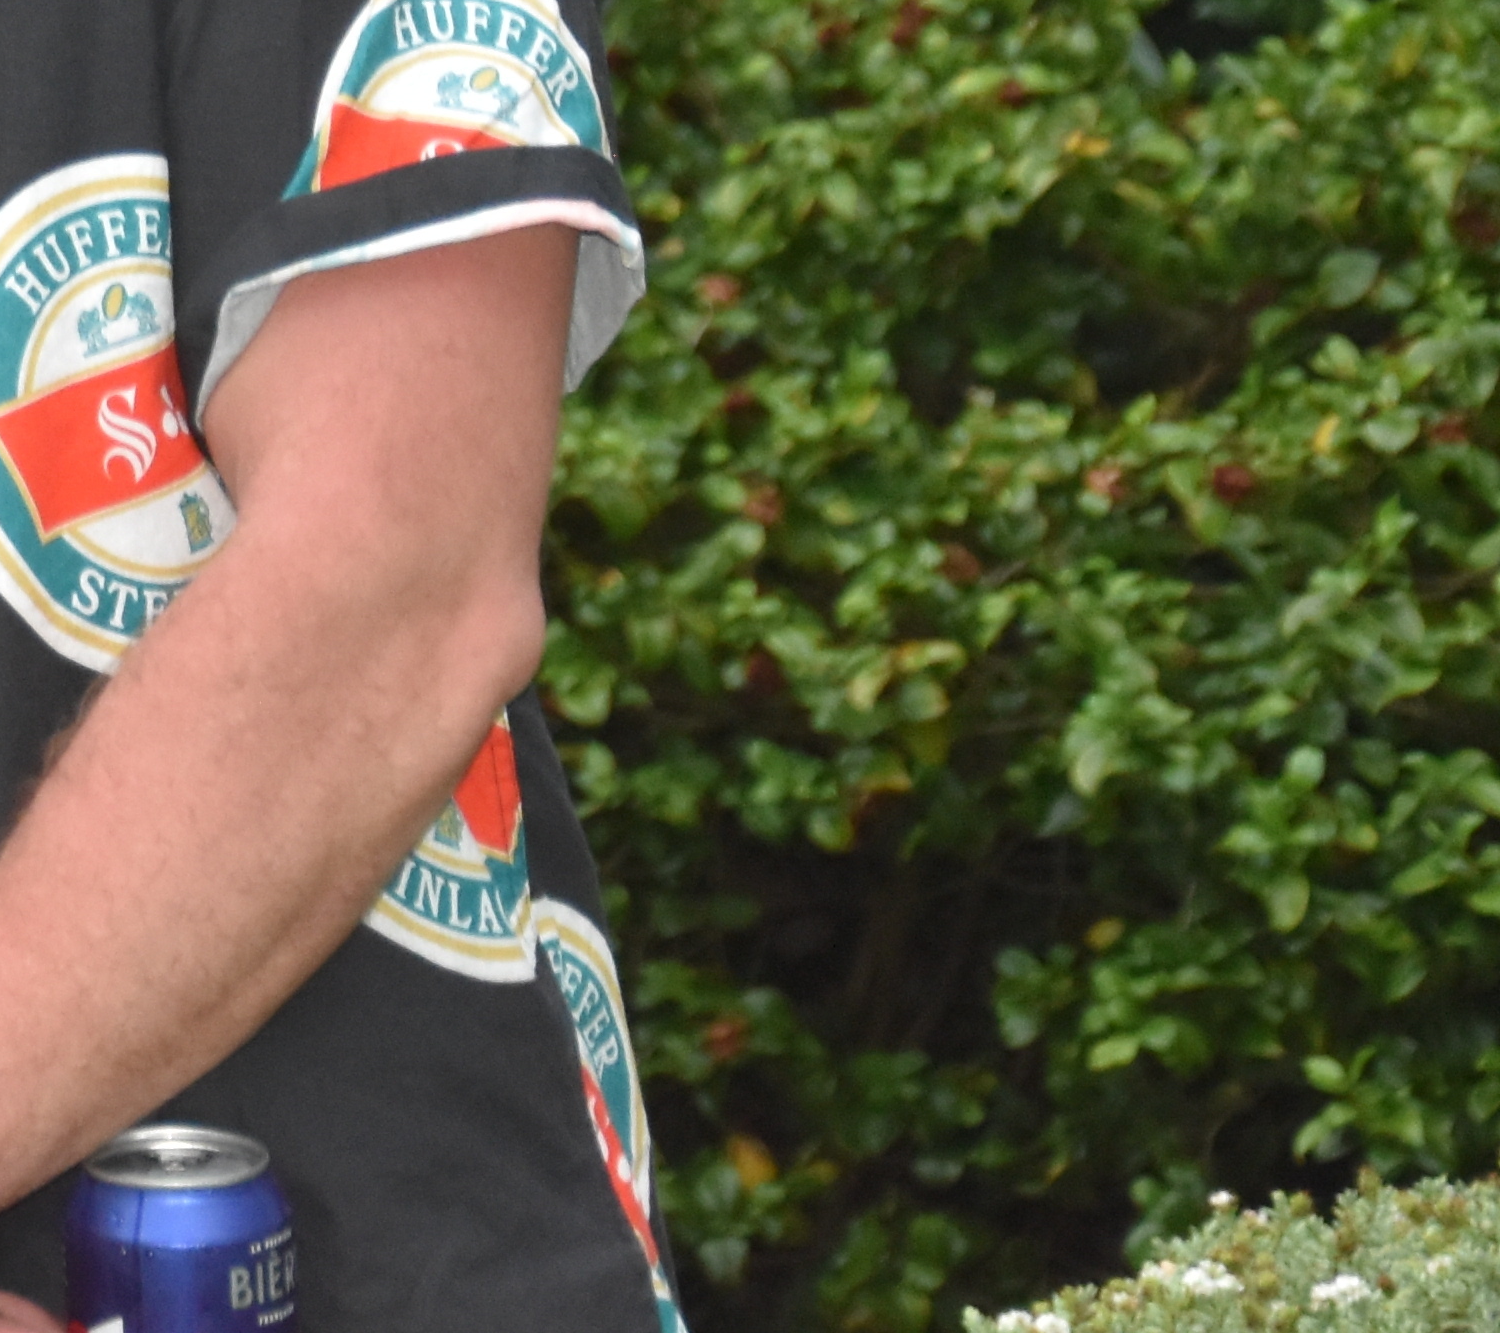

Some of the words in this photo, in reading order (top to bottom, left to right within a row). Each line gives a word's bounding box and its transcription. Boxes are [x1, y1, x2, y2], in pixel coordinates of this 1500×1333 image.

[393, 0, 579, 108] HUFFER
[5, 207, 171, 314] HUFFE
[395, 860, 506, 933] INLA
